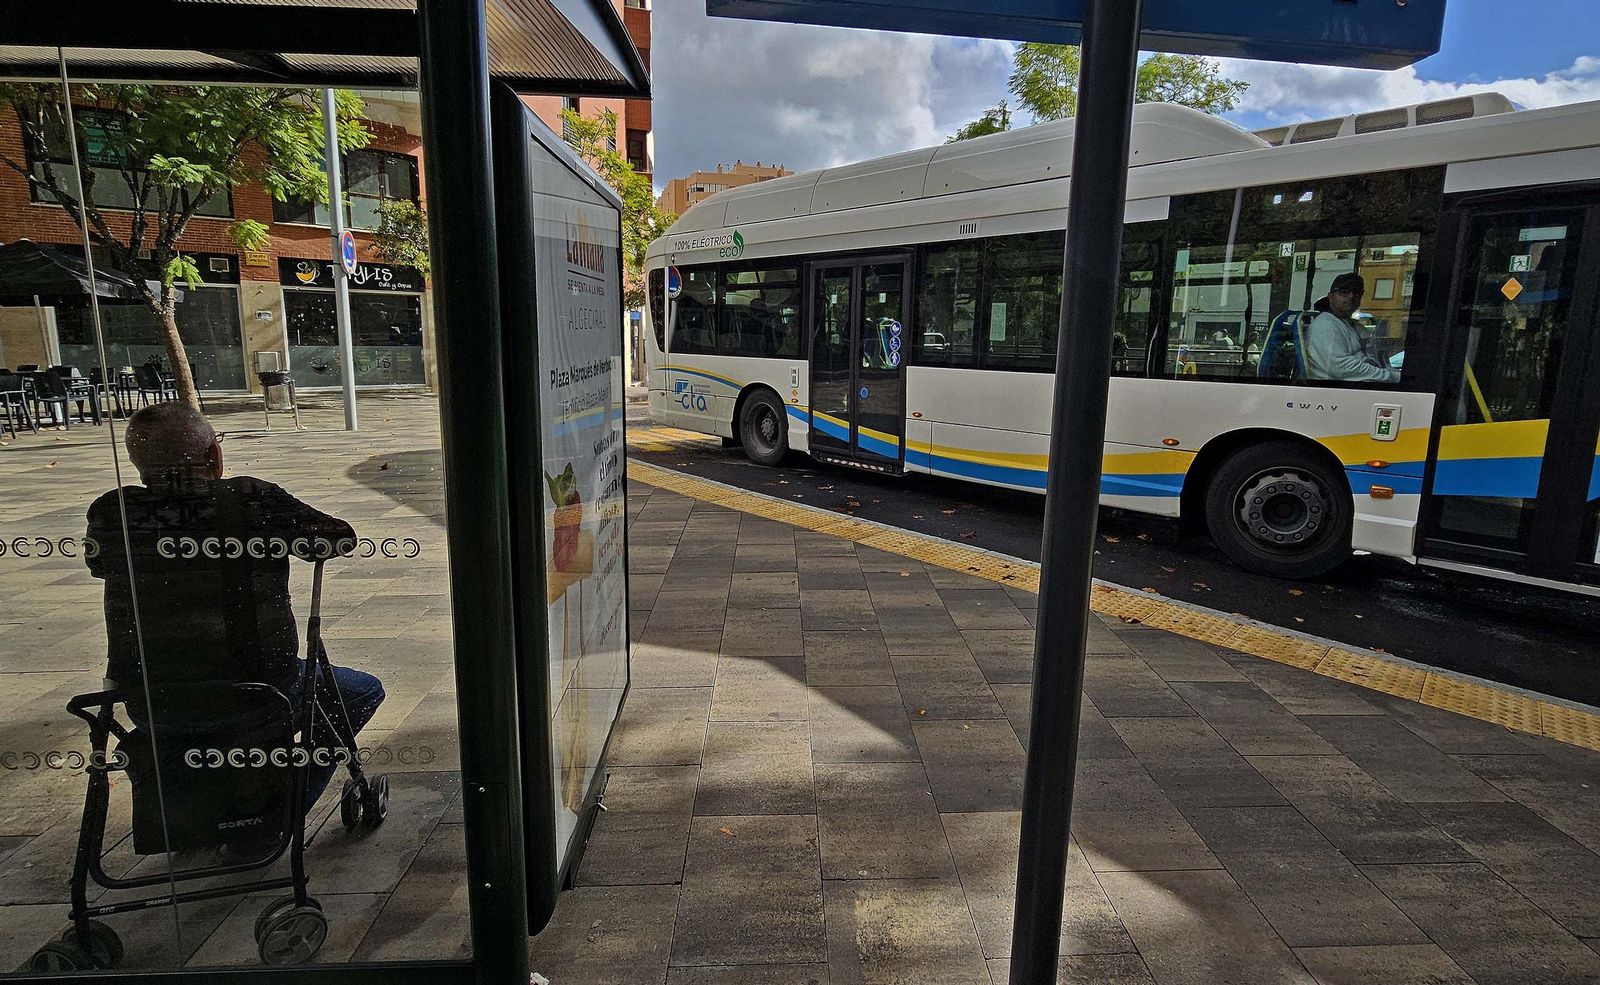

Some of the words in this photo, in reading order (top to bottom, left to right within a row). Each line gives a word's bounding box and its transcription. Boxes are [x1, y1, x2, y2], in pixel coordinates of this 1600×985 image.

[674, 240, 690, 251] 100%
[691, 234, 733, 249] ELÉCTRICO
[719, 246, 739, 258] eco
[550, 368, 570, 390] Plaza
